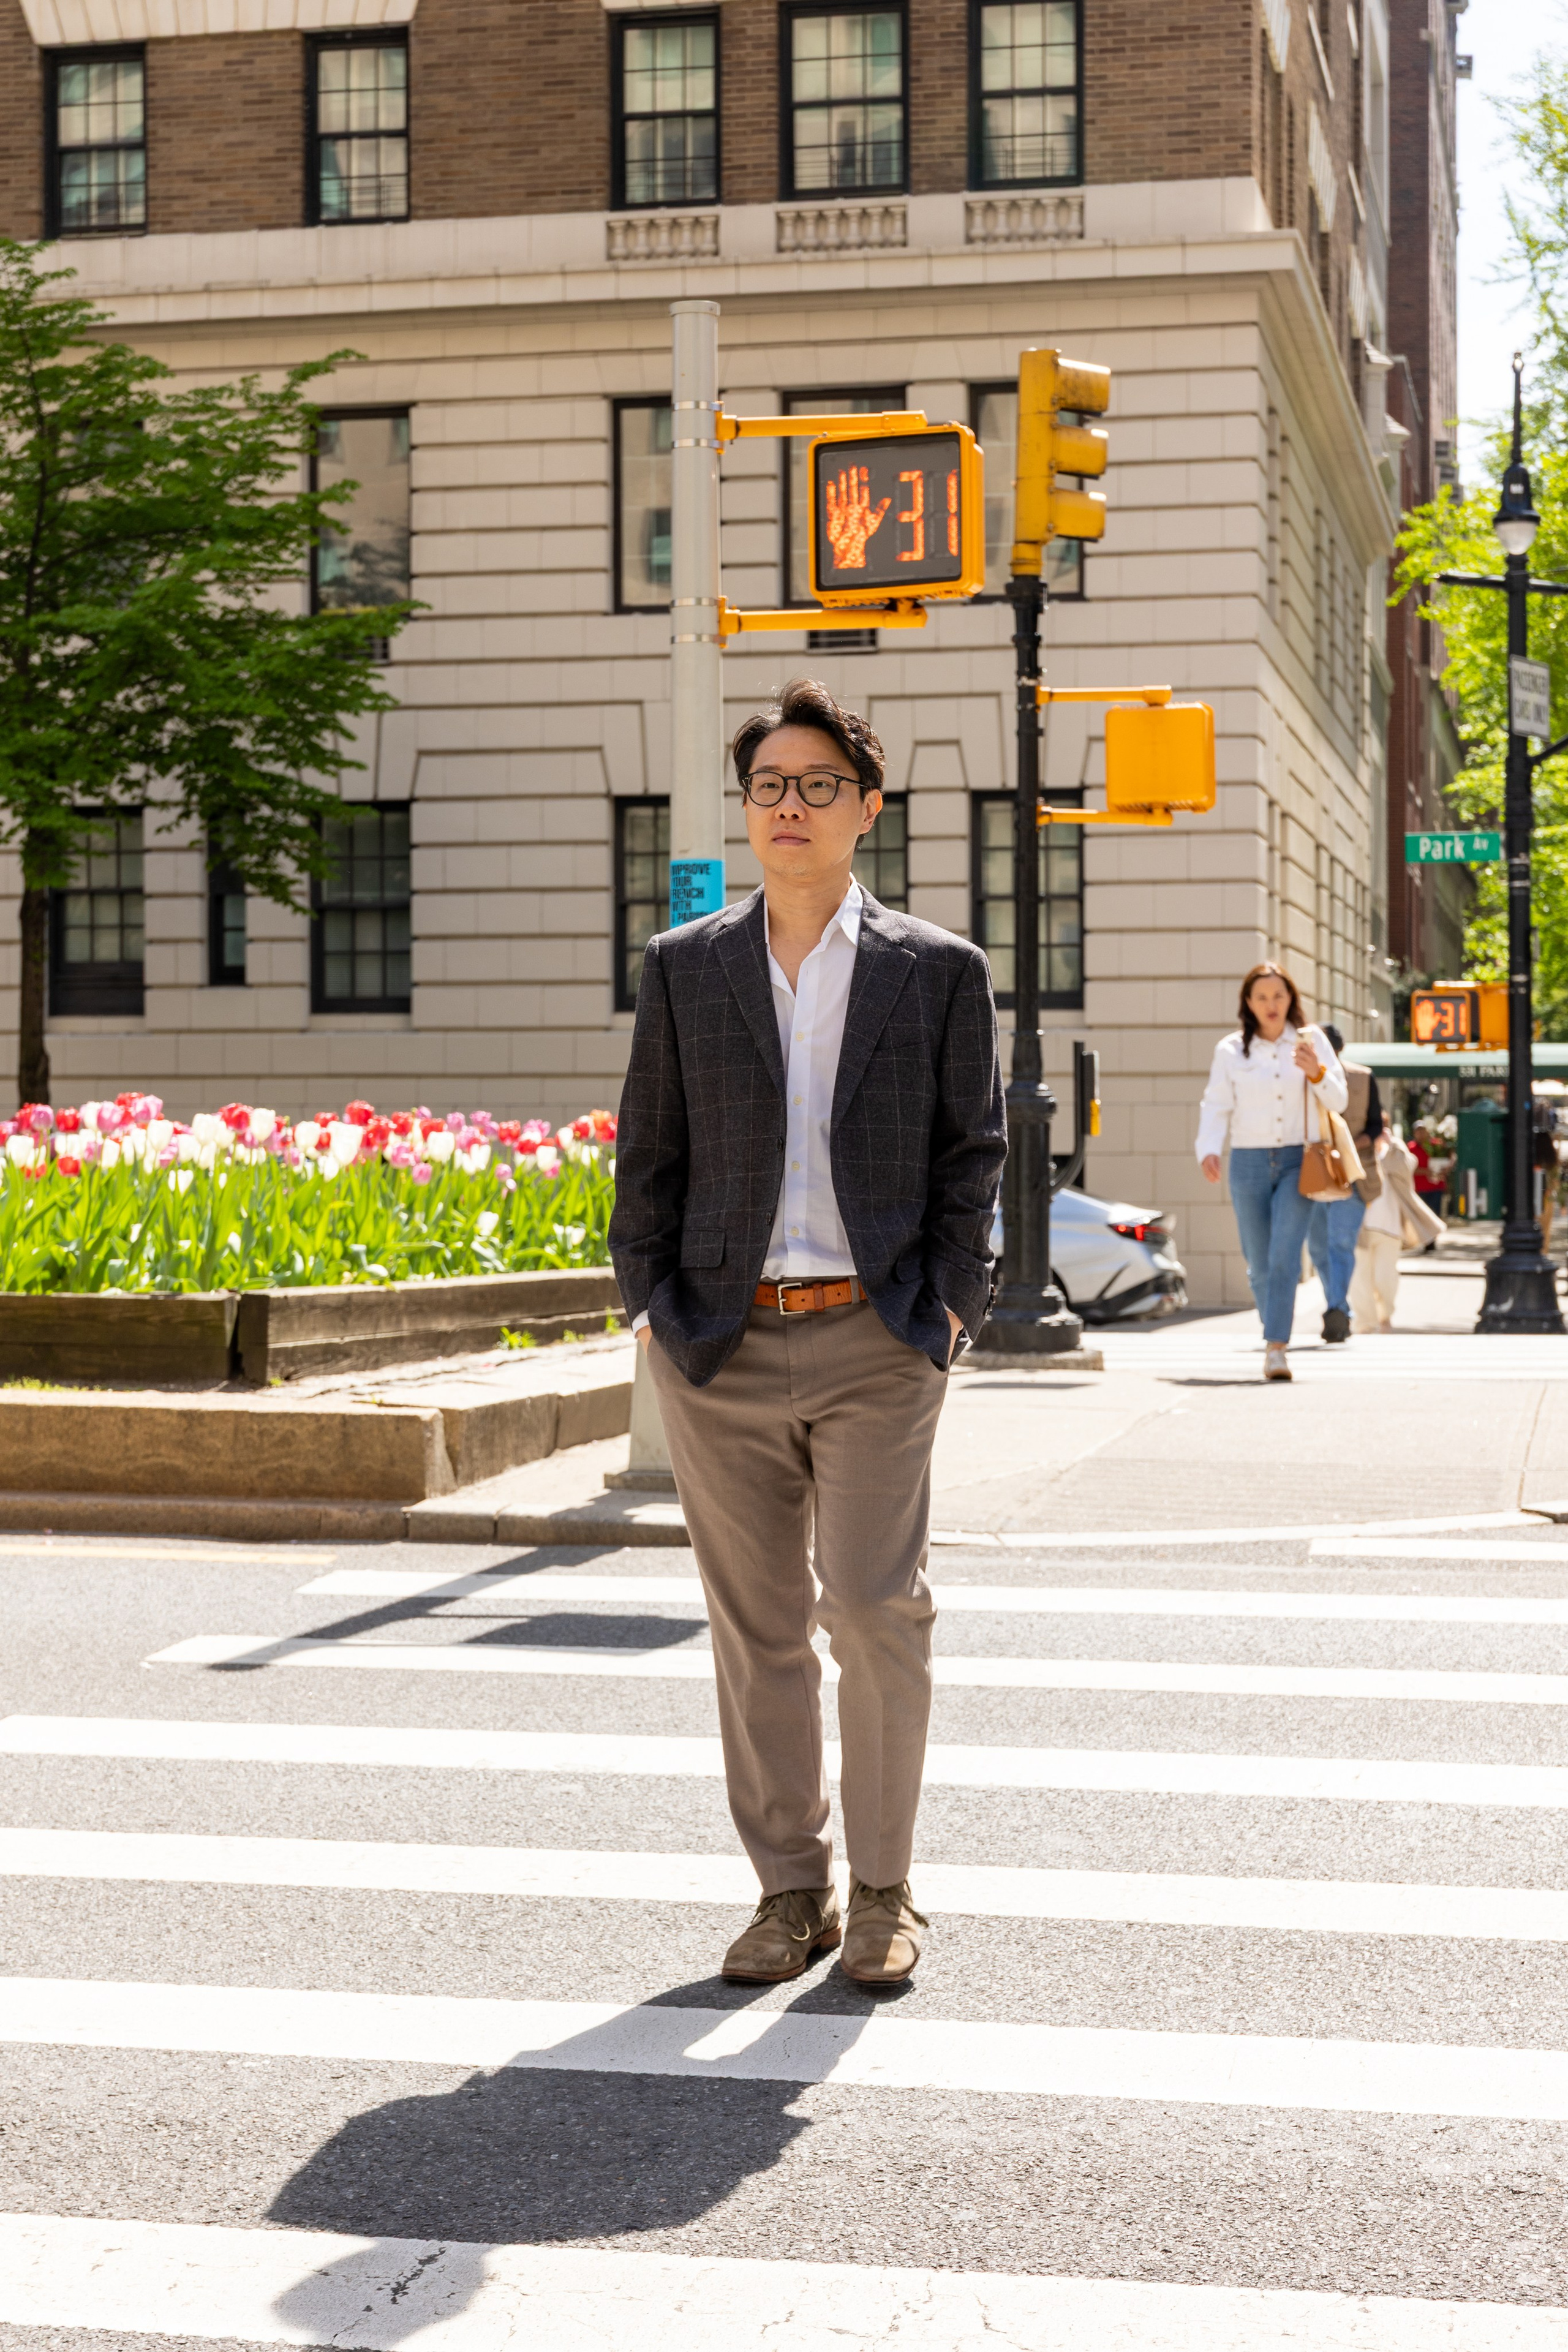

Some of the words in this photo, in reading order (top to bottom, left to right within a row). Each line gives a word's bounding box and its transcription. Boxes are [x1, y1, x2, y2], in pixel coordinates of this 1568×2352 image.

[896, 469, 959, 562] 31
[1419, 836, 1465, 860] Park
[1472, 835, 1489, 851] Av
[1441, 1001, 1466, 1037] 31
